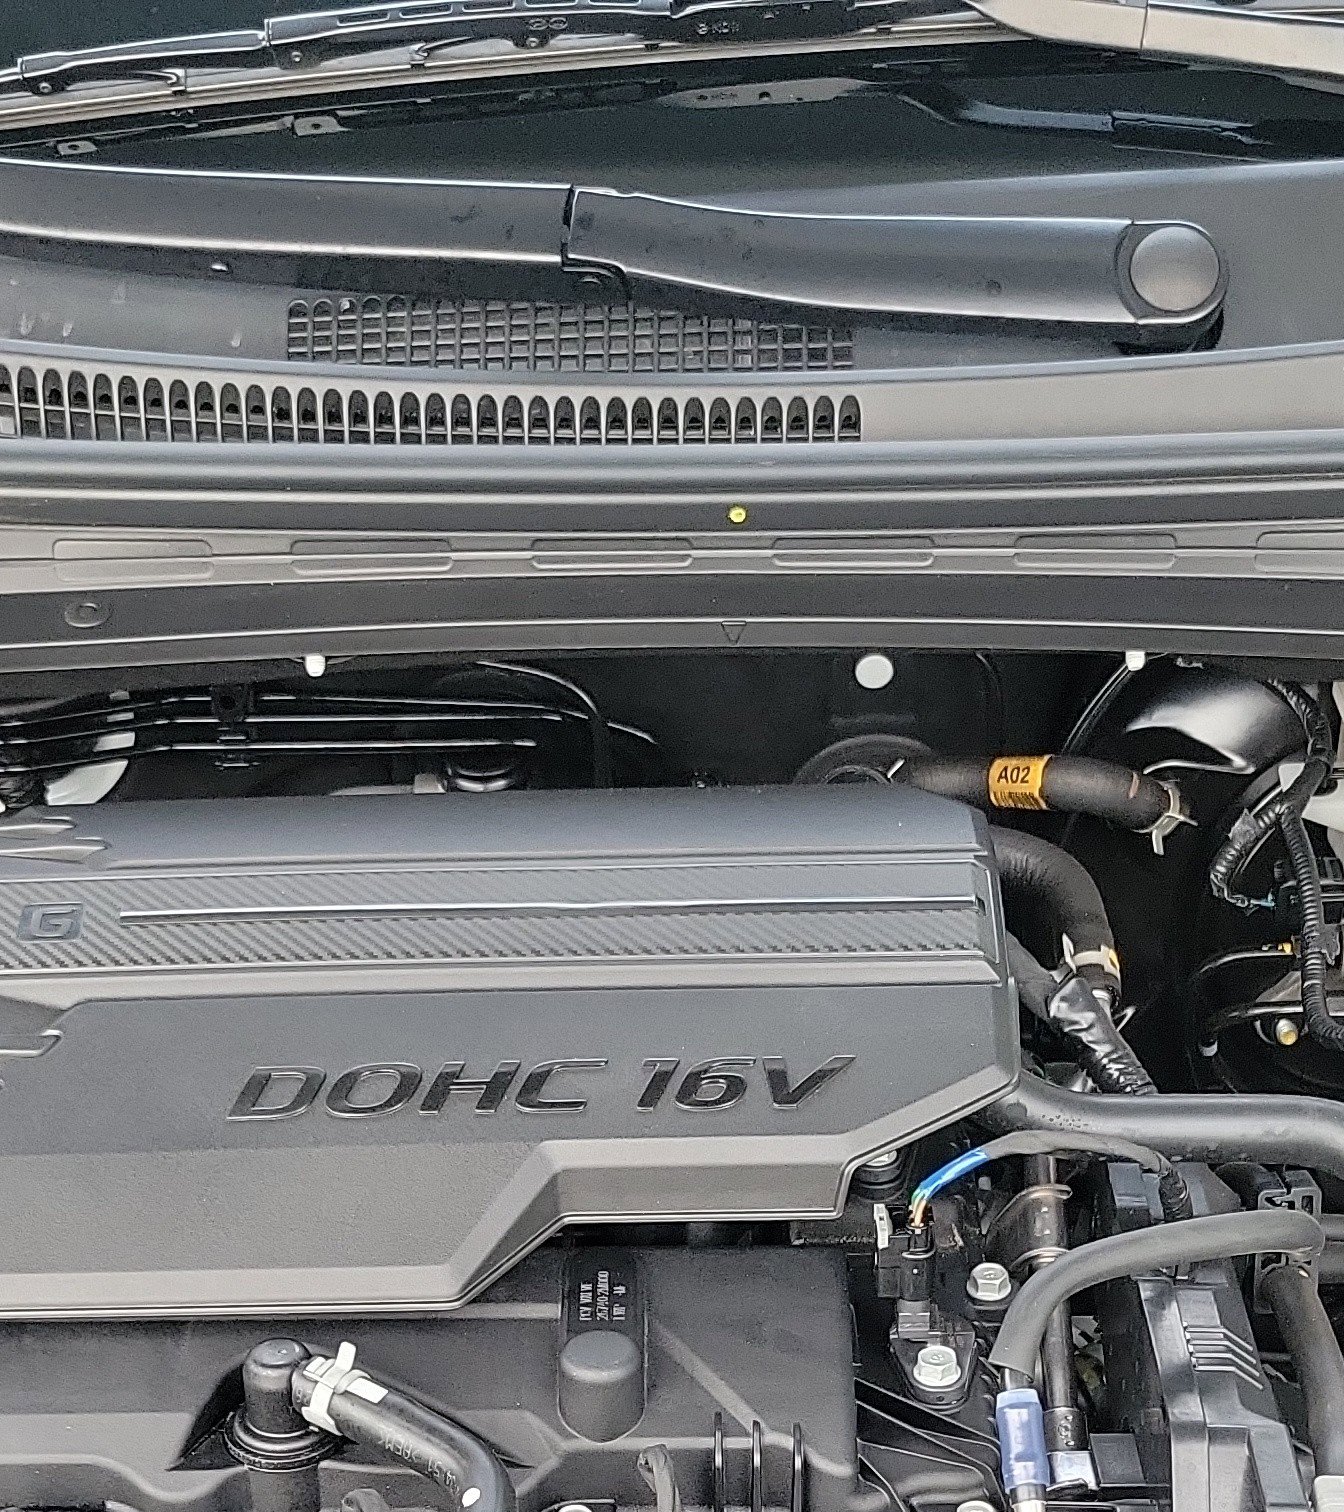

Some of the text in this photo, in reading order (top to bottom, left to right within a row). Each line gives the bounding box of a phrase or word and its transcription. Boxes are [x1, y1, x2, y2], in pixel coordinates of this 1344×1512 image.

[997, 766, 1031, 784] A02
[22, 902, 84, 941] G
[226, 1054, 858, 1121] DOHC 16V
